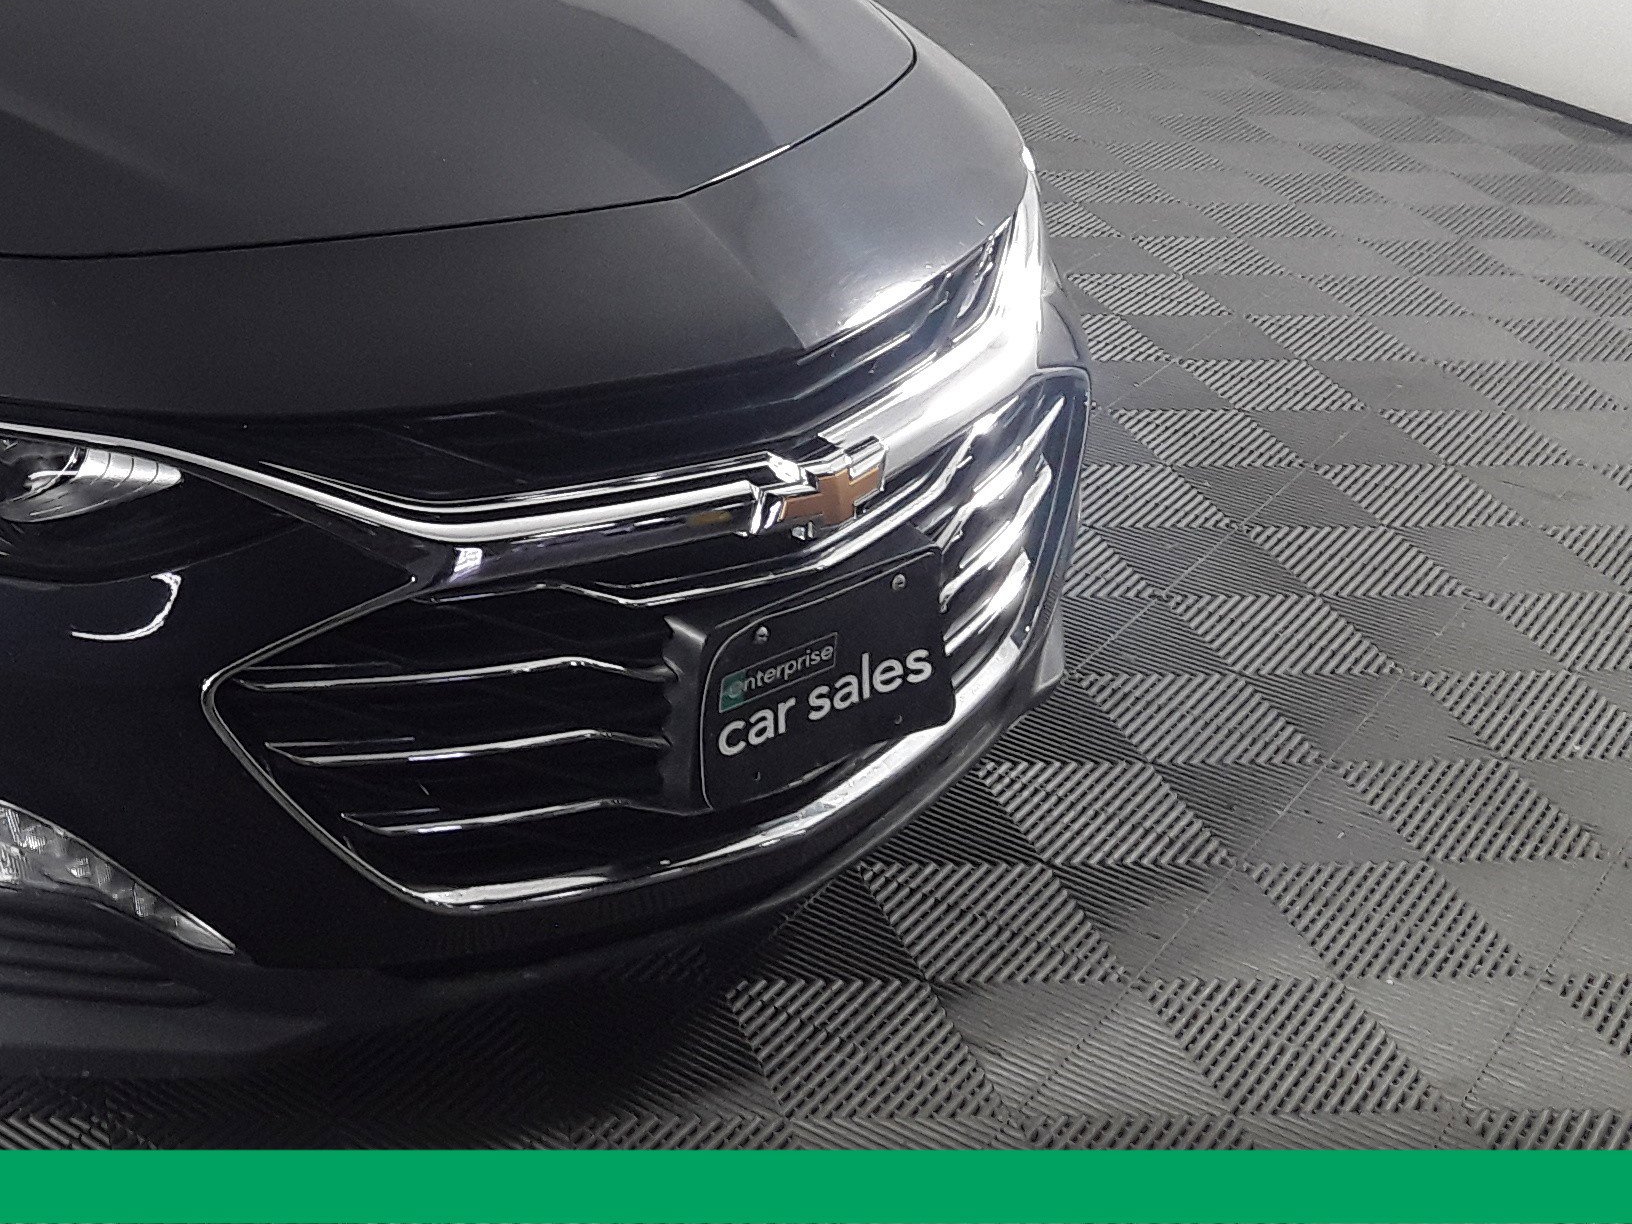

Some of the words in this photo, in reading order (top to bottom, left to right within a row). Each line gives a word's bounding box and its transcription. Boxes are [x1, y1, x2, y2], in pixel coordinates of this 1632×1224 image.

[718, 697, 796, 757] car
[807, 648, 933, 721] sales
[729, 645, 835, 700] enterprise
